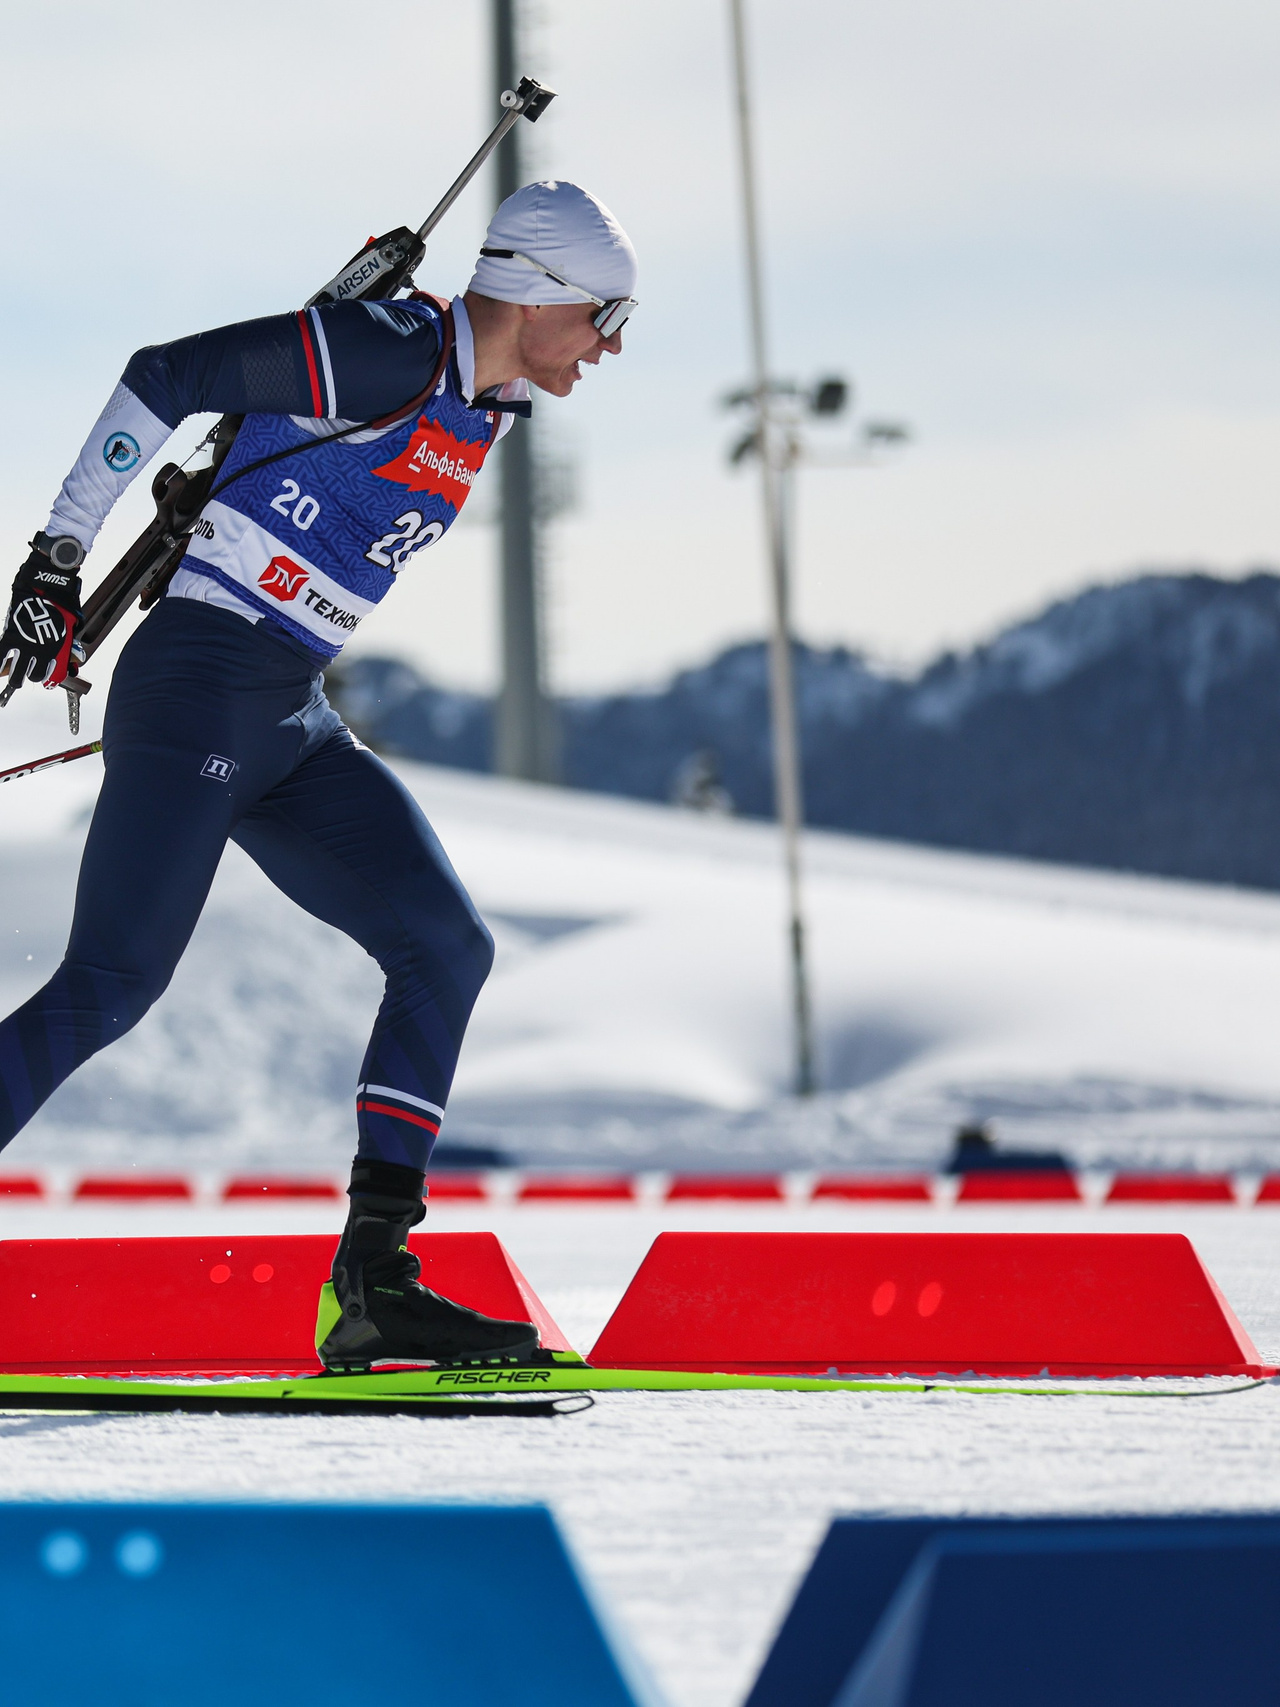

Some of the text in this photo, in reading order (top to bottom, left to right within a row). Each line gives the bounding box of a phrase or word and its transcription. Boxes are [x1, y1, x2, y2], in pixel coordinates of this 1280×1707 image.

[333, 257, 381, 300] ARSEN
[413, 440, 455, 479] Альфа
[269, 478, 321, 531] 20
[363, 508, 445, 575] 20
[33, 570, 71, 586] SWIX
[435, 1371, 551, 1385] FISCHER
